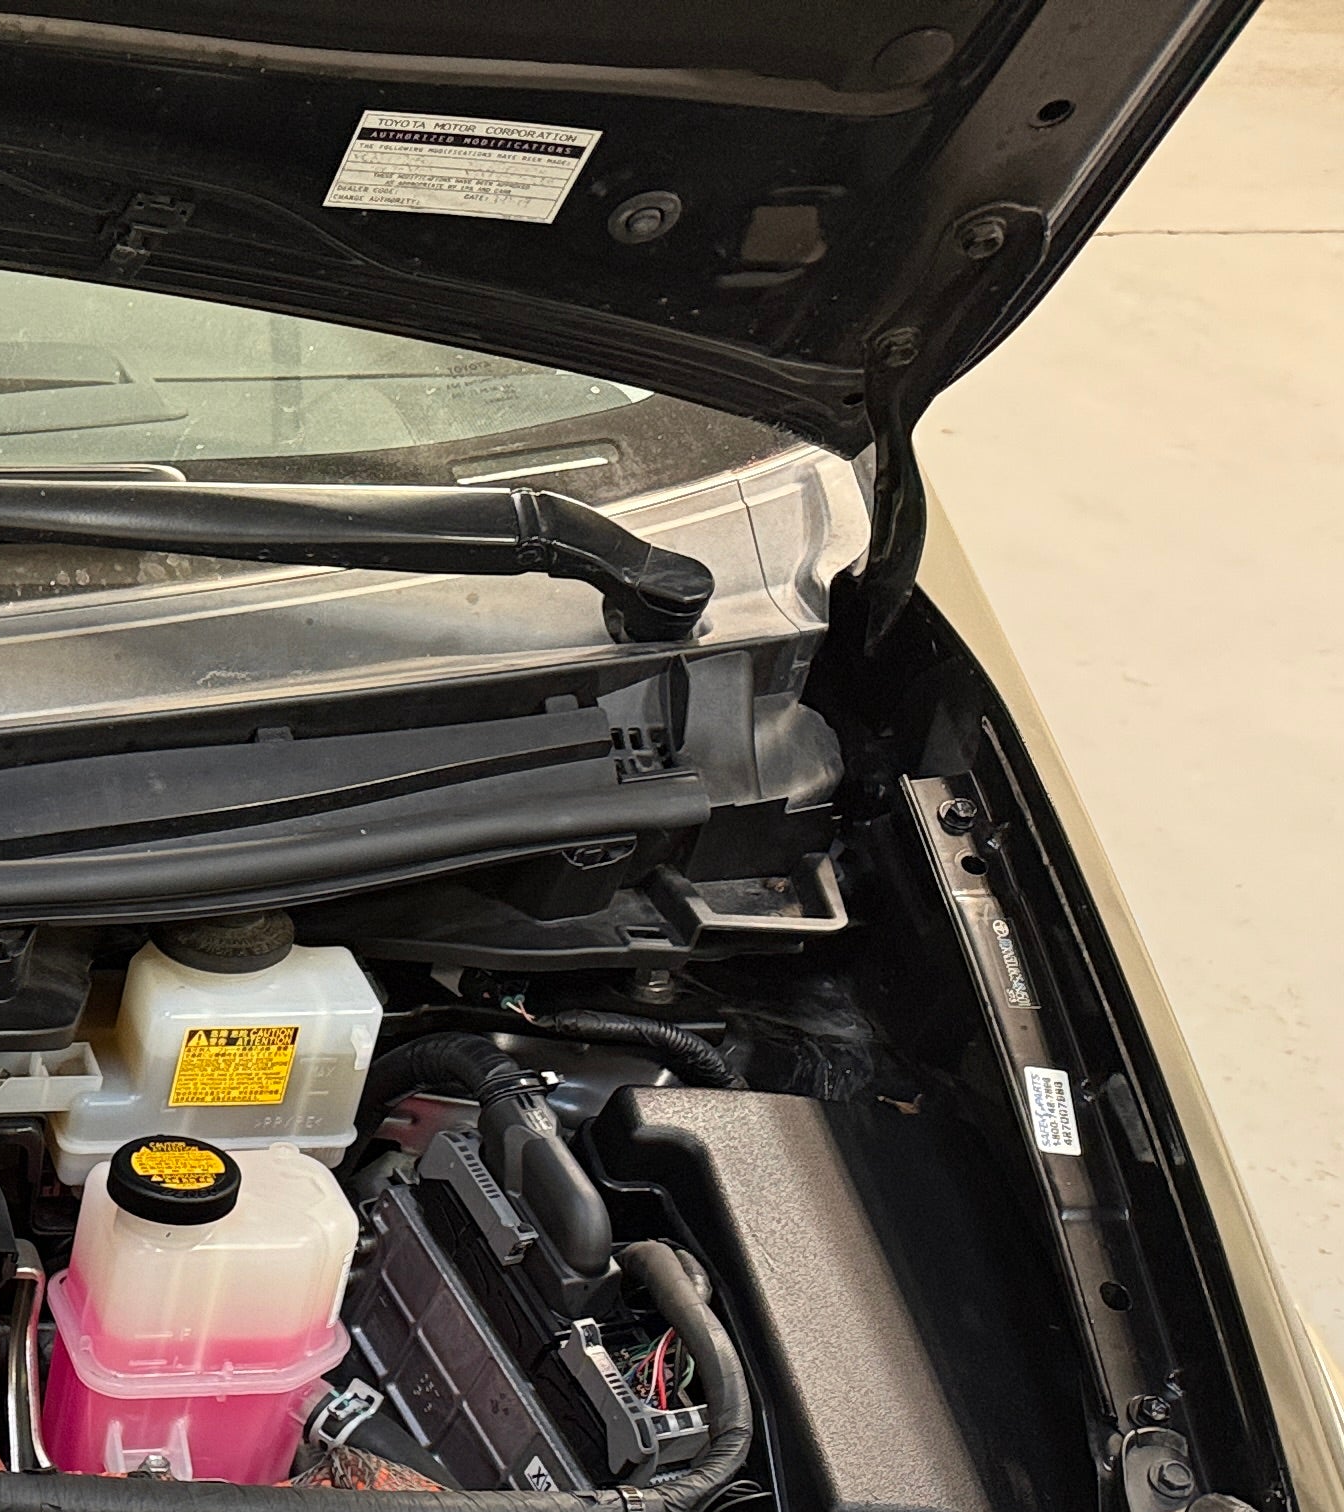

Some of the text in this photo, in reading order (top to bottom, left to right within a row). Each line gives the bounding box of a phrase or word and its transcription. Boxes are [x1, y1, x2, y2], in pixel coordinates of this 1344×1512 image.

[377, 117, 576, 142] TOYOTA MOTOR CORPORATION
[370, 130, 572, 155] AUTHORIZED MODIFICATIONS
